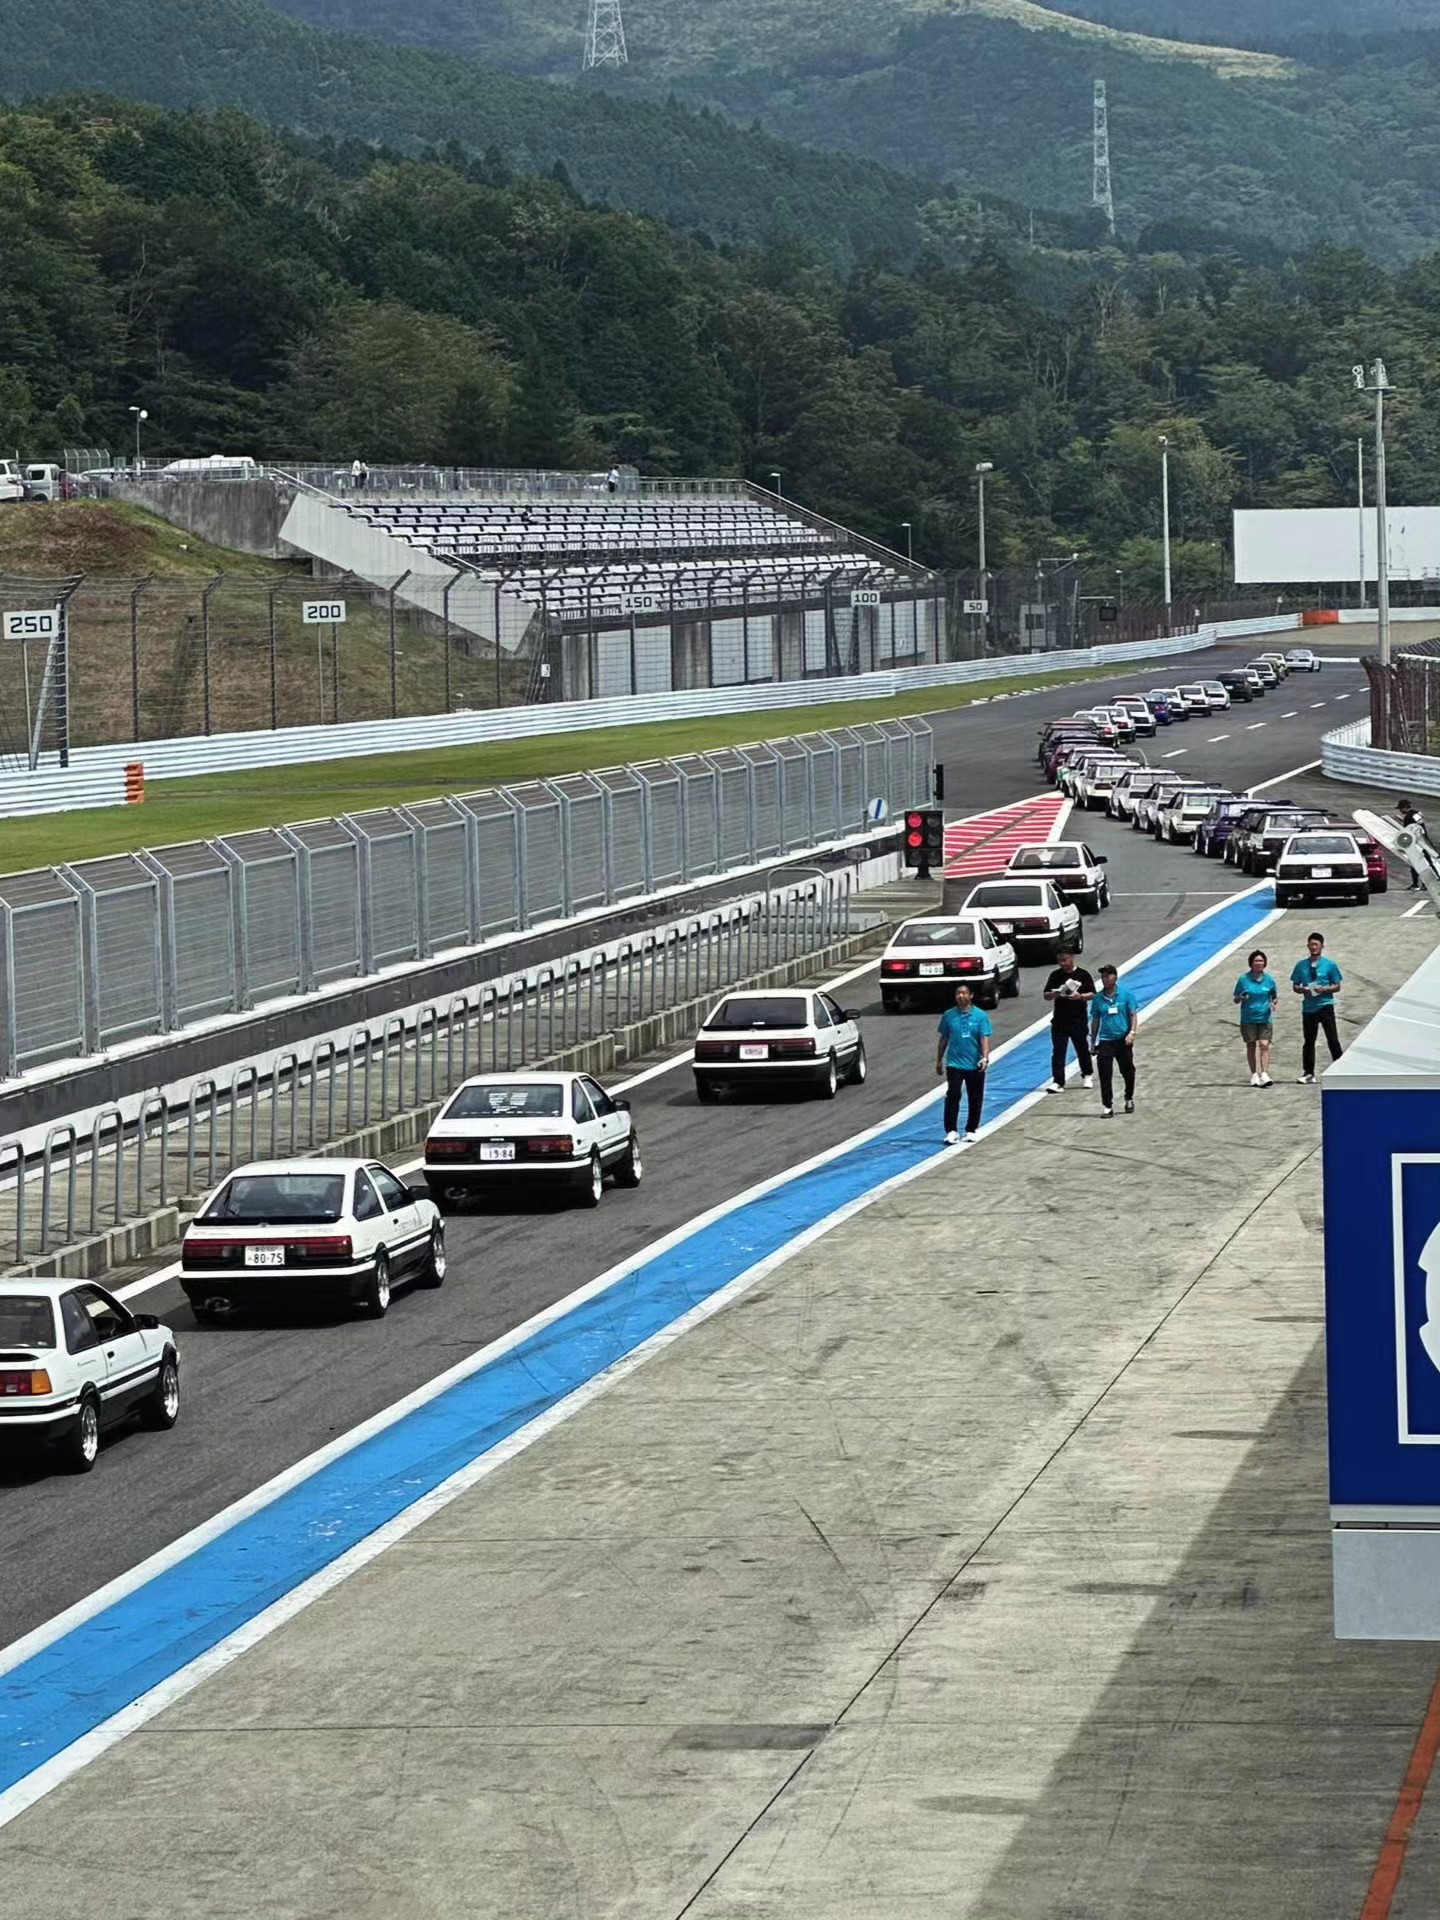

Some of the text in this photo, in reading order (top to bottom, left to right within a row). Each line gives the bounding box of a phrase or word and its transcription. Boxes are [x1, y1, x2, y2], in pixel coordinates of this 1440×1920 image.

[625, 596, 652, 608] 150
[854, 593, 877, 603] 100
[308, 605, 341, 618] 200
[969, 602, 983, 611] 50
[10, 616, 52, 633] 250
